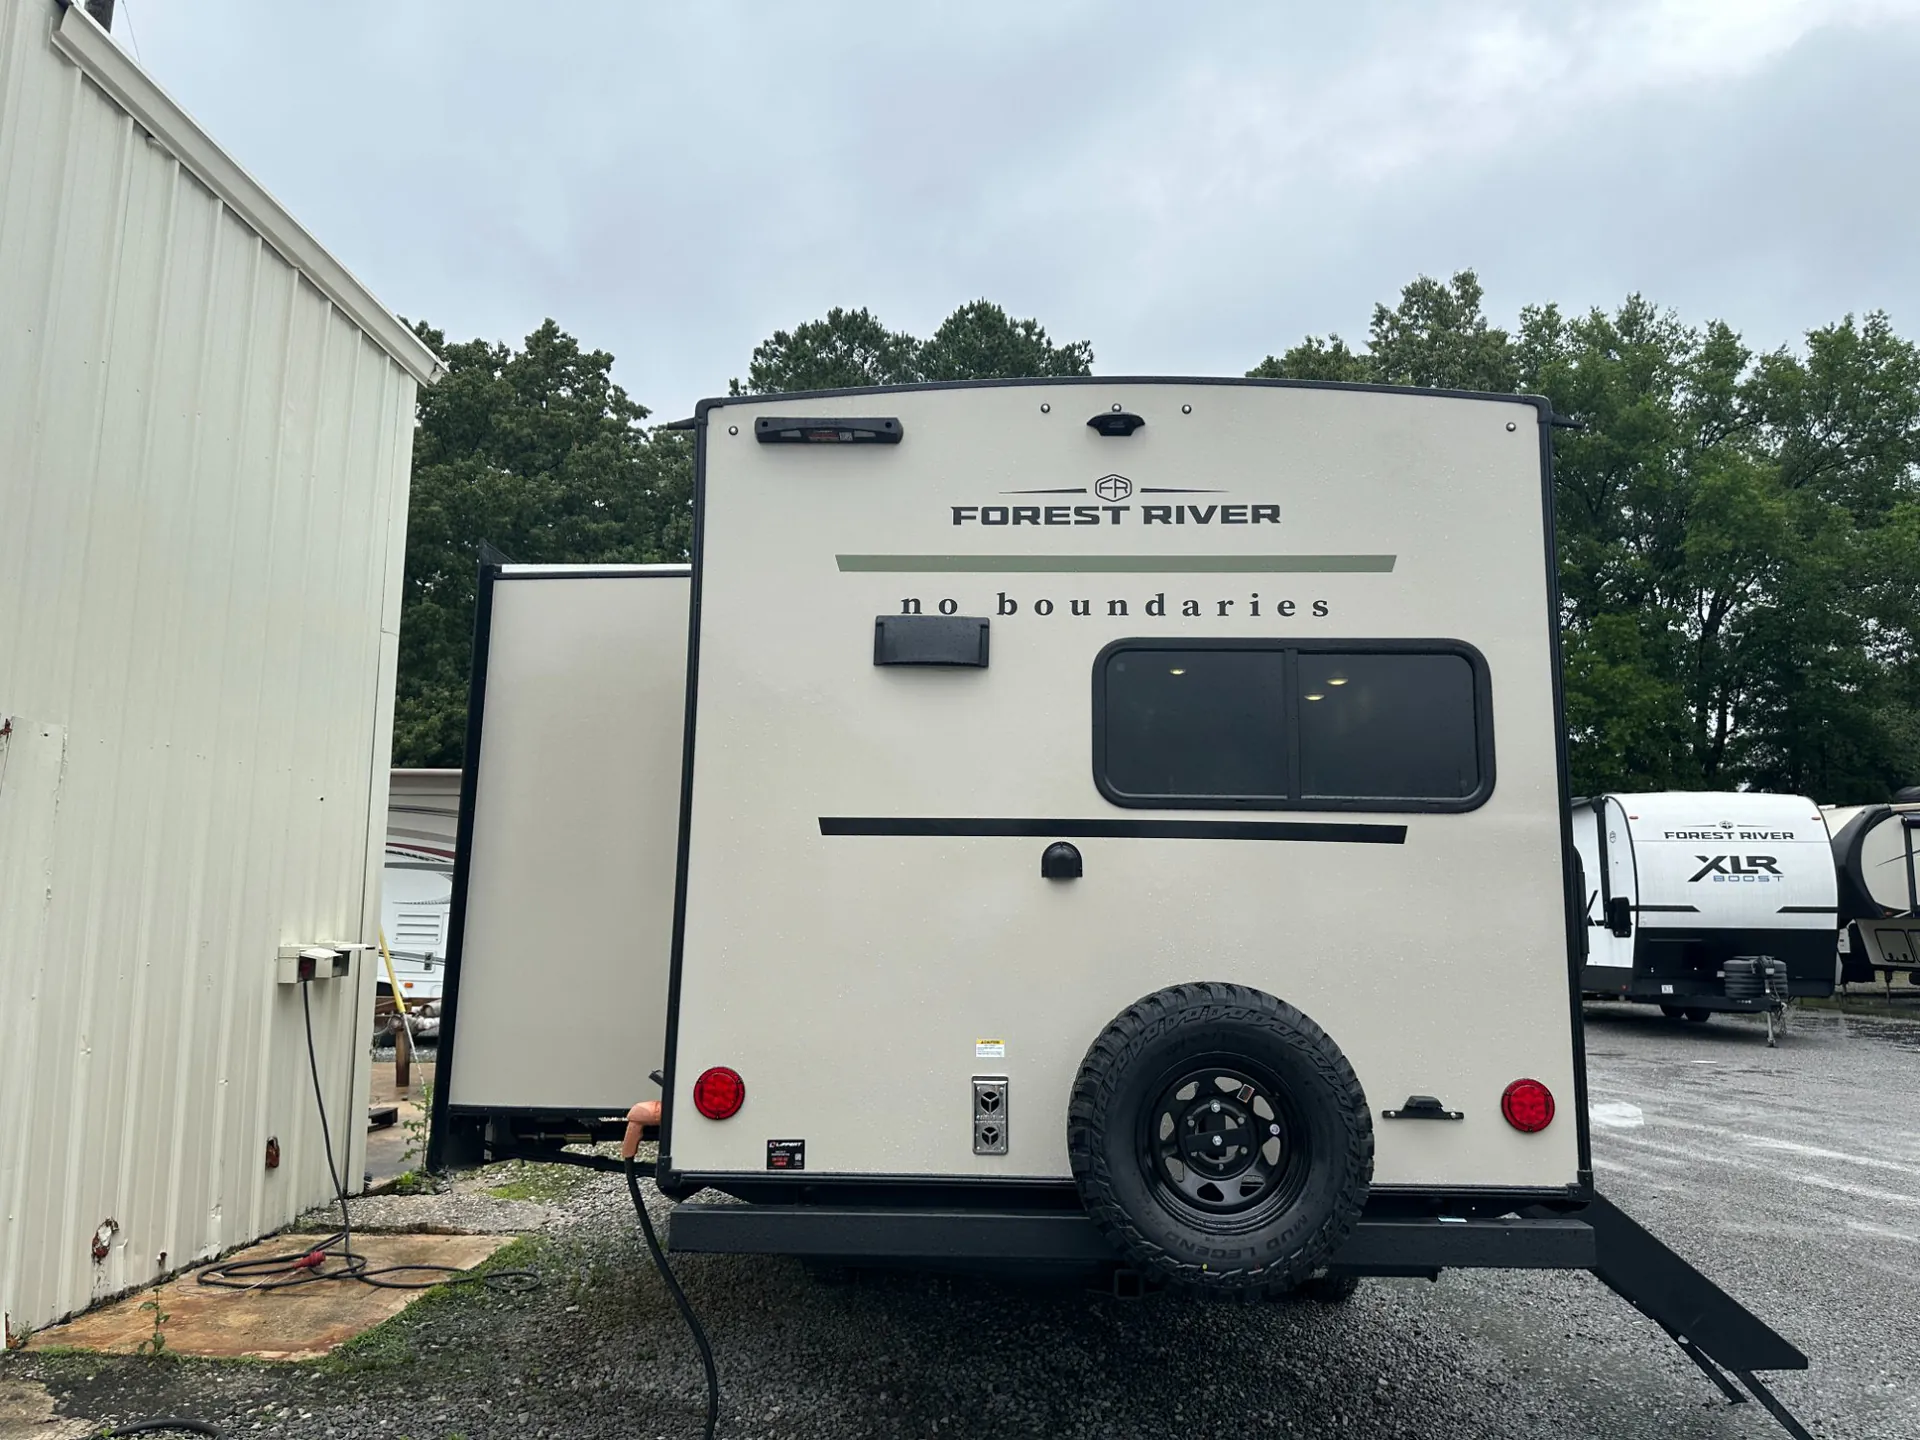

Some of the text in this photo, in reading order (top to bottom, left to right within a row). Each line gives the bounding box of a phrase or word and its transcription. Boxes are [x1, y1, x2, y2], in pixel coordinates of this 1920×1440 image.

[951, 505, 1281, 525] FOREST RIVER
[901, 592, 1329, 617] no boundaries
[1664, 831, 1795, 840] FOREST RIVER
[1687, 855, 1783, 882] XLR
[1164, 1214, 1308, 1260] MUD LEGEND
